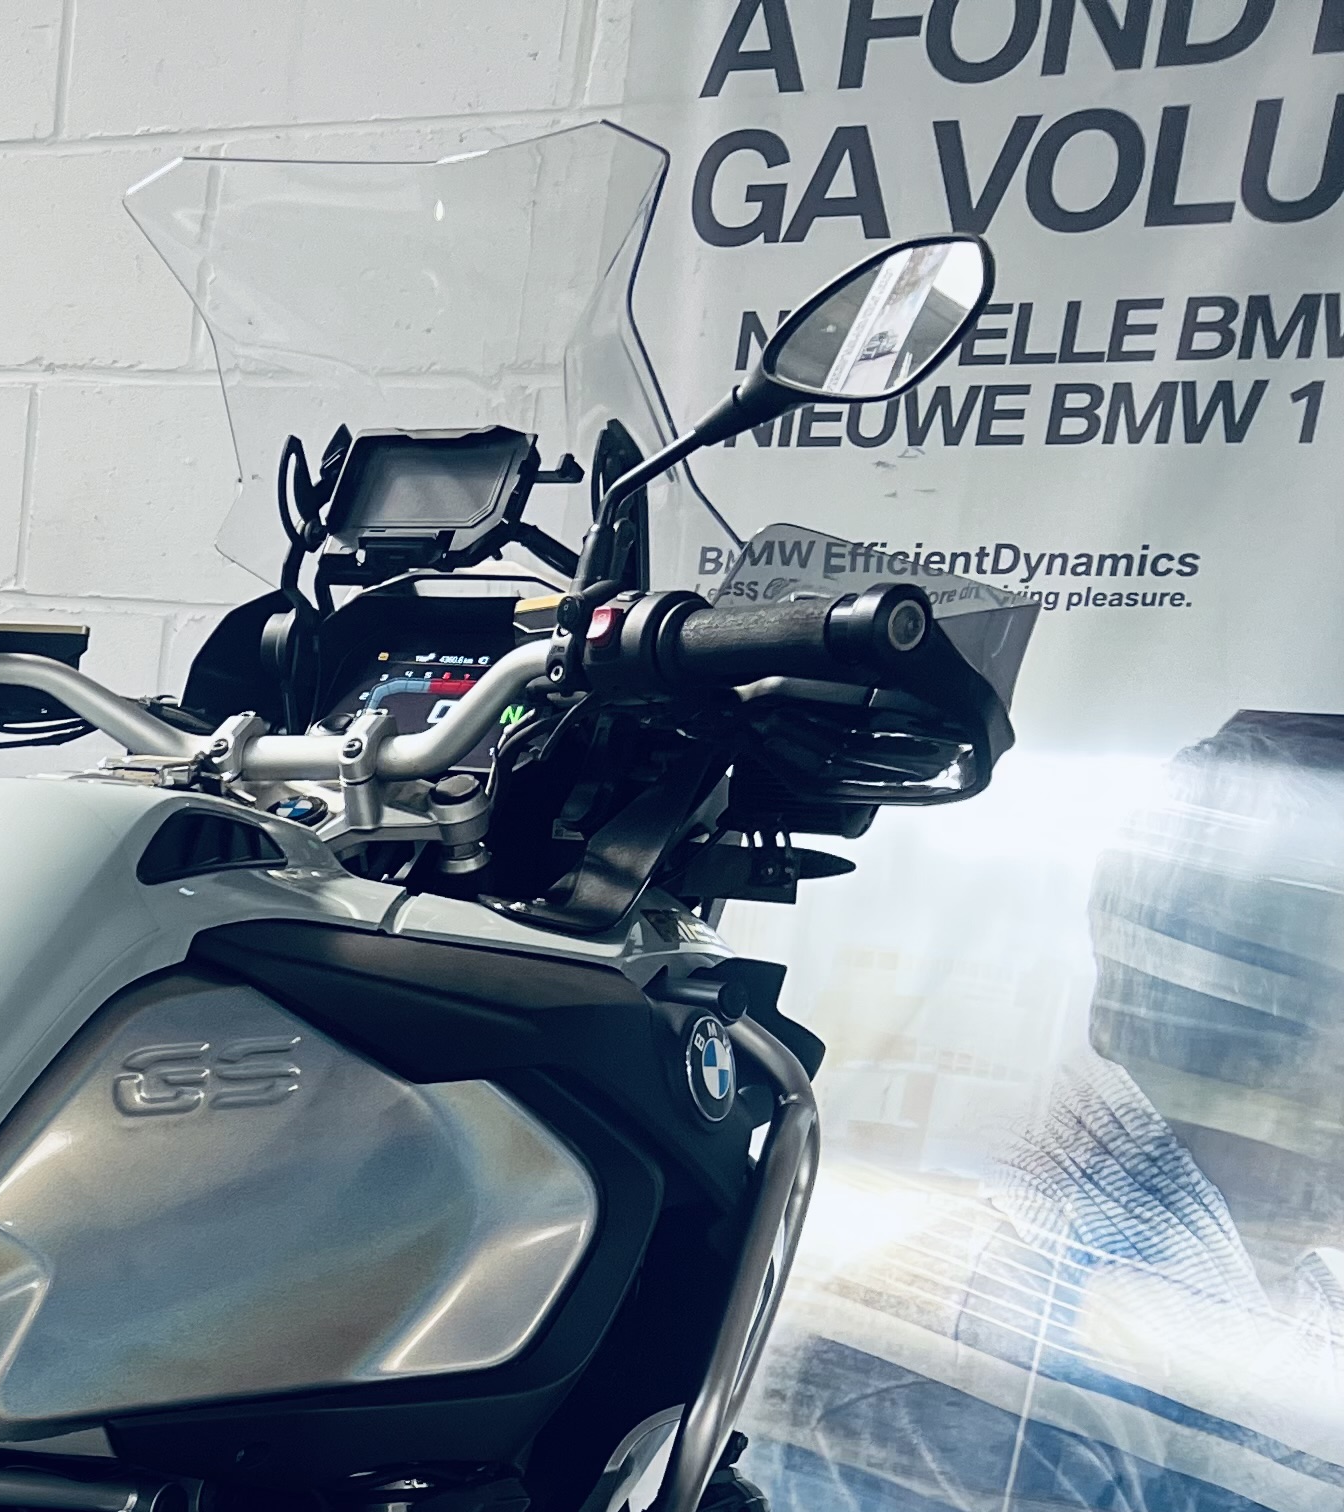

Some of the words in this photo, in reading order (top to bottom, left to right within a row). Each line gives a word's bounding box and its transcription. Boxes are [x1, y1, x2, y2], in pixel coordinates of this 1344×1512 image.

[699, 0, 805, 98] A
[837, 0, 1276, 90] FOND
[690, 124, 892, 248] GA
[932, 93, 1344, 234] VOLU
[1175, 293, 1344, 365] BM
[1043, 379, 1269, 445] BMW
[1287, 380, 1324, 443] 1
[823, 541, 1201, 584] EfficientDynamics
[1065, 586, 1193, 610] pleasure.
[113, 1036, 302, 1117] GS
